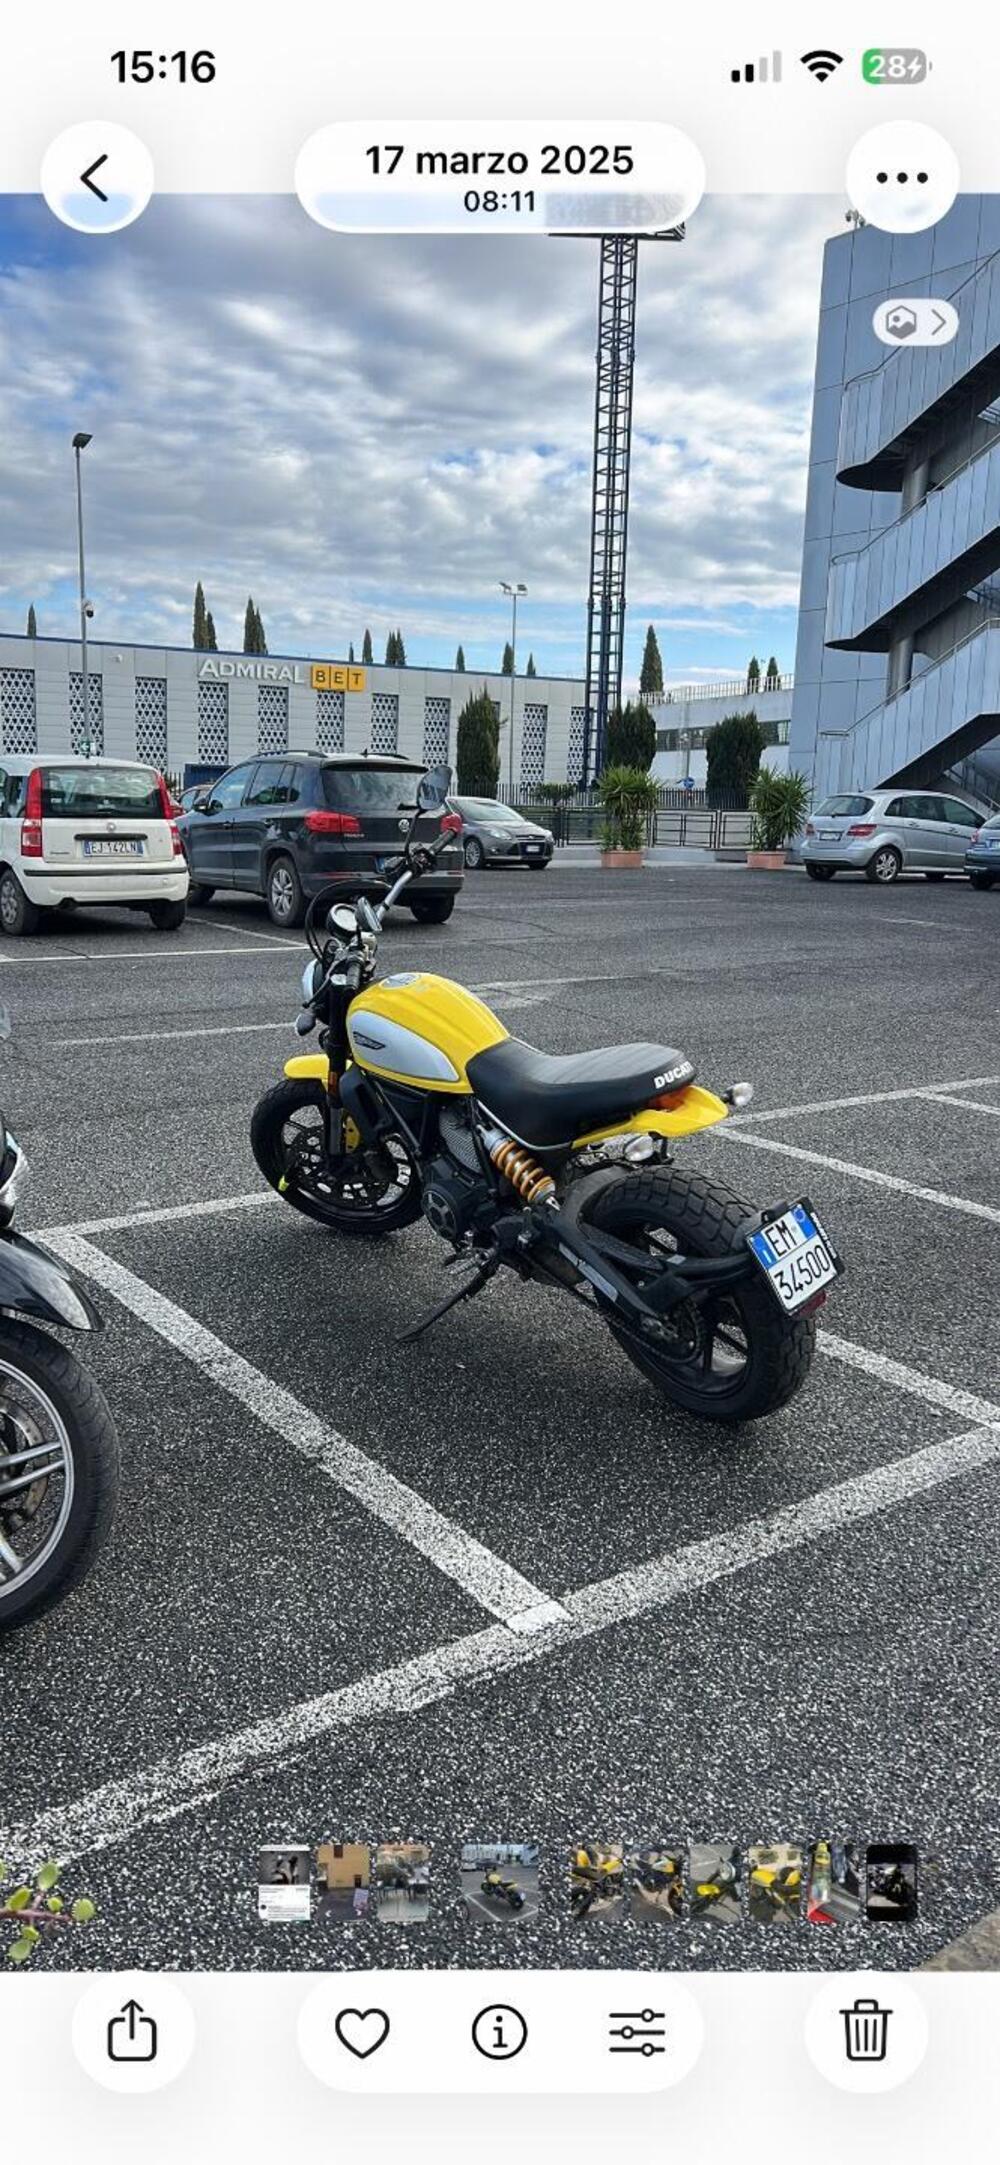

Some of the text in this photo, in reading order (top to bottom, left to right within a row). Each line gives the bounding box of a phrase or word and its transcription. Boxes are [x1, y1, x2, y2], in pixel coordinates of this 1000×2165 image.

[199, 659, 362, 685] ADMIRAL BET
[764, 1220, 798, 1257] EM
[774, 1245, 831, 1300] 34500
